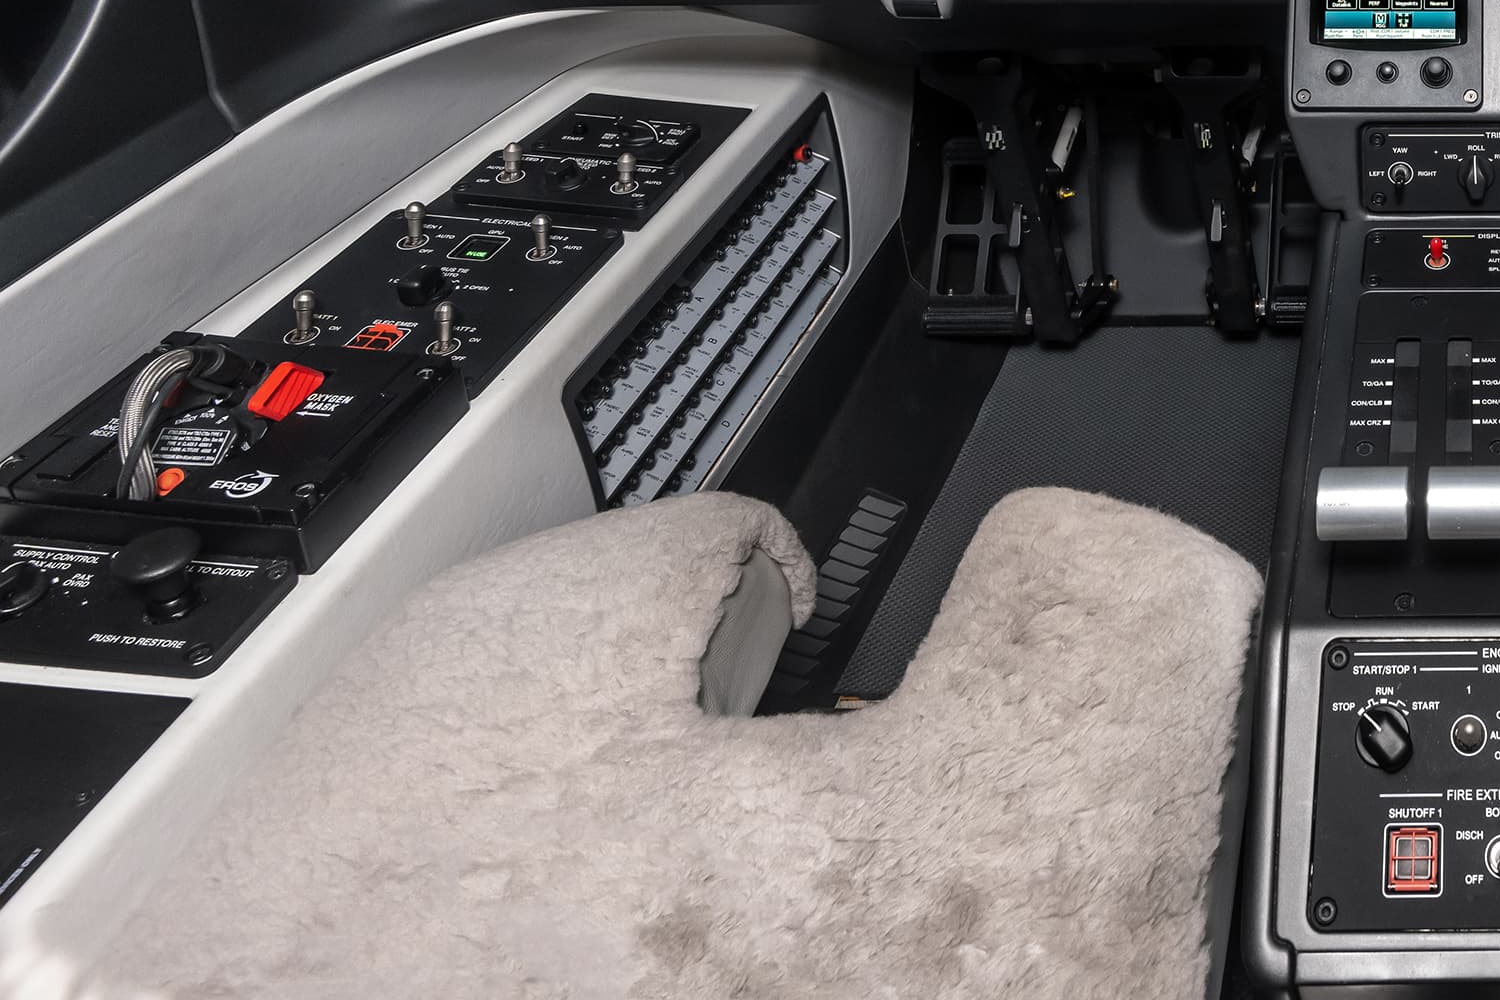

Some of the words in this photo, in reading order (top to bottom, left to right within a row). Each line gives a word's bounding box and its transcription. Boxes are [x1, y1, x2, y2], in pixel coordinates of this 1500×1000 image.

[306, 393, 354, 405] OXYGEN
[303, 402, 340, 413] MASK
[209, 480, 259, 492] EROS
[13, 549, 50, 560] SUPPLY
[52, 551, 101, 565] CONTROL
[88, 633, 121, 647] PUSH
[123, 637, 135, 647] TO
[136, 637, 186, 649] RESTORE
[1352, 664, 1412, 675] START/STOP
[1375, 686, 1394, 696] RUN
[1332, 702, 1356, 712] STOP
[1411, 701, 1440, 711] START
[1446, 789, 1474, 800] FIRE
[1388, 807, 1437, 818] SHUTOFF
[1455, 830, 1484, 840] DISCH
[1465, 874, 1484, 884] OFF
